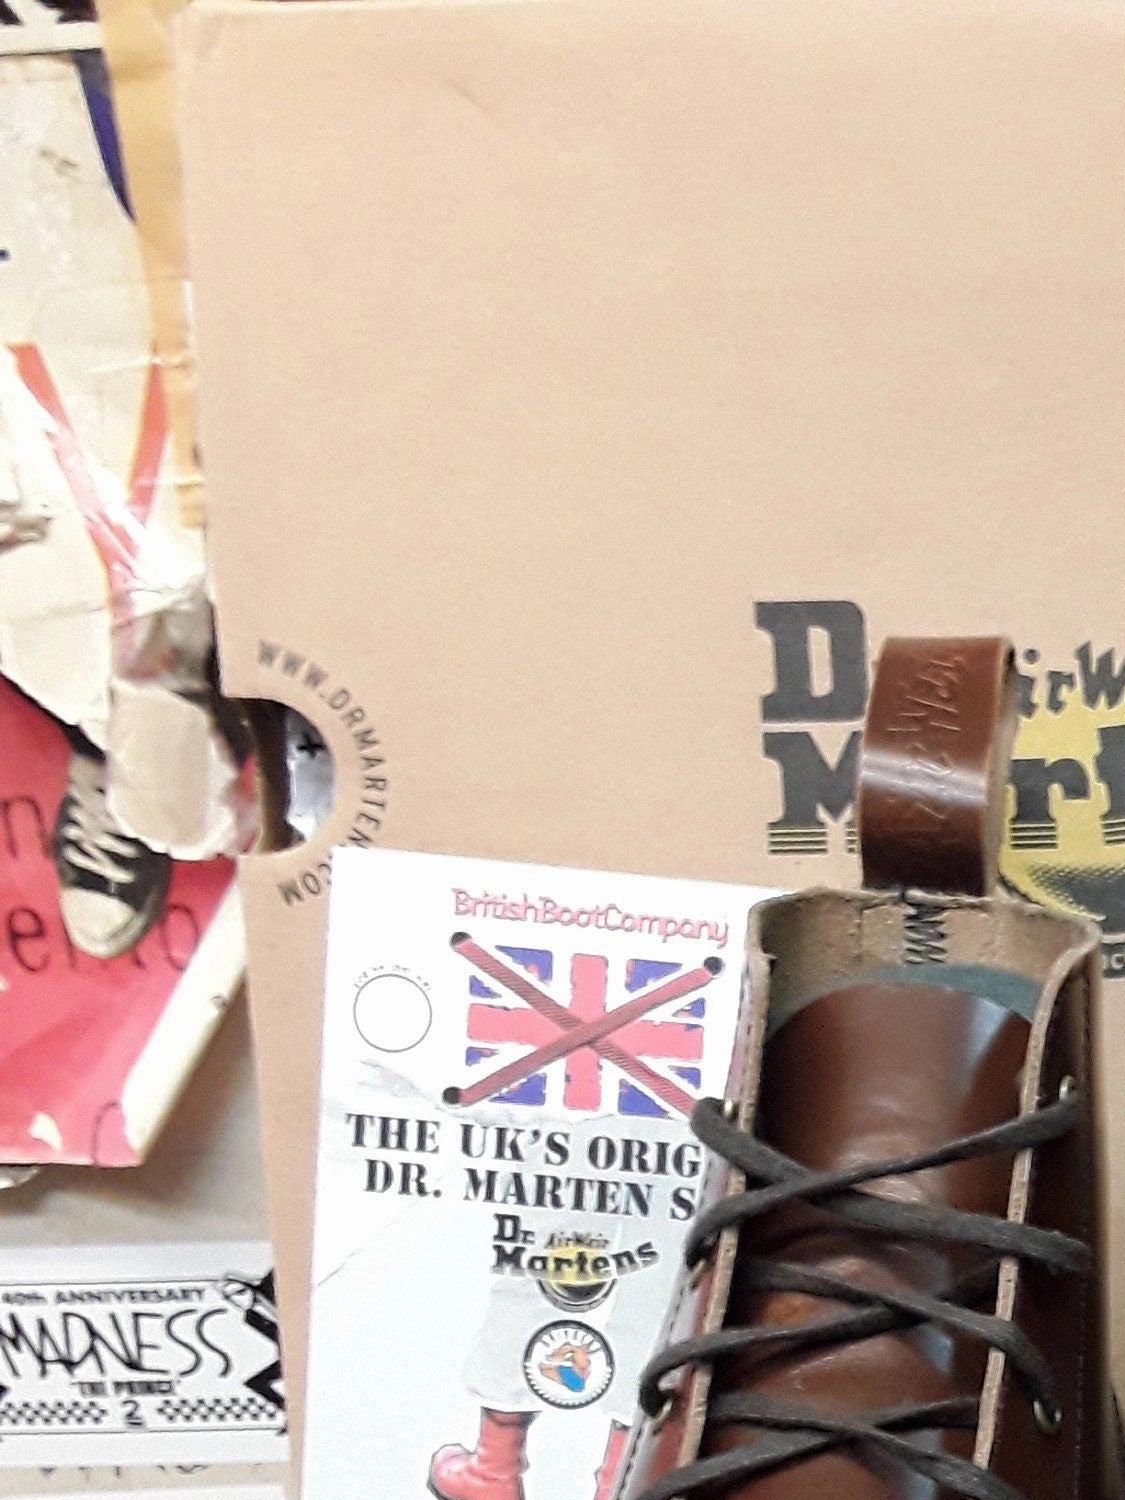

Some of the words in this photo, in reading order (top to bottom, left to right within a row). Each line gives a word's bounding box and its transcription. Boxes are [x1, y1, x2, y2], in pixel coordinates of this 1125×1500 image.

[755, 601, 868, 723] D
[452, 889, 728, 948] BritishBootCompany
[346, 1113, 441, 1154] THE
[460, 1123, 570, 1167] UK'S
[588, 1136, 700, 1178] ORIG
[364, 1159, 443, 1198] DR.
[464, 1168, 653, 1217] MARTEN
[669, 1187, 697, 1221] S
[490, 1241, 660, 1278] Martens
[0, 1308, 230, 1379] MADNESS
